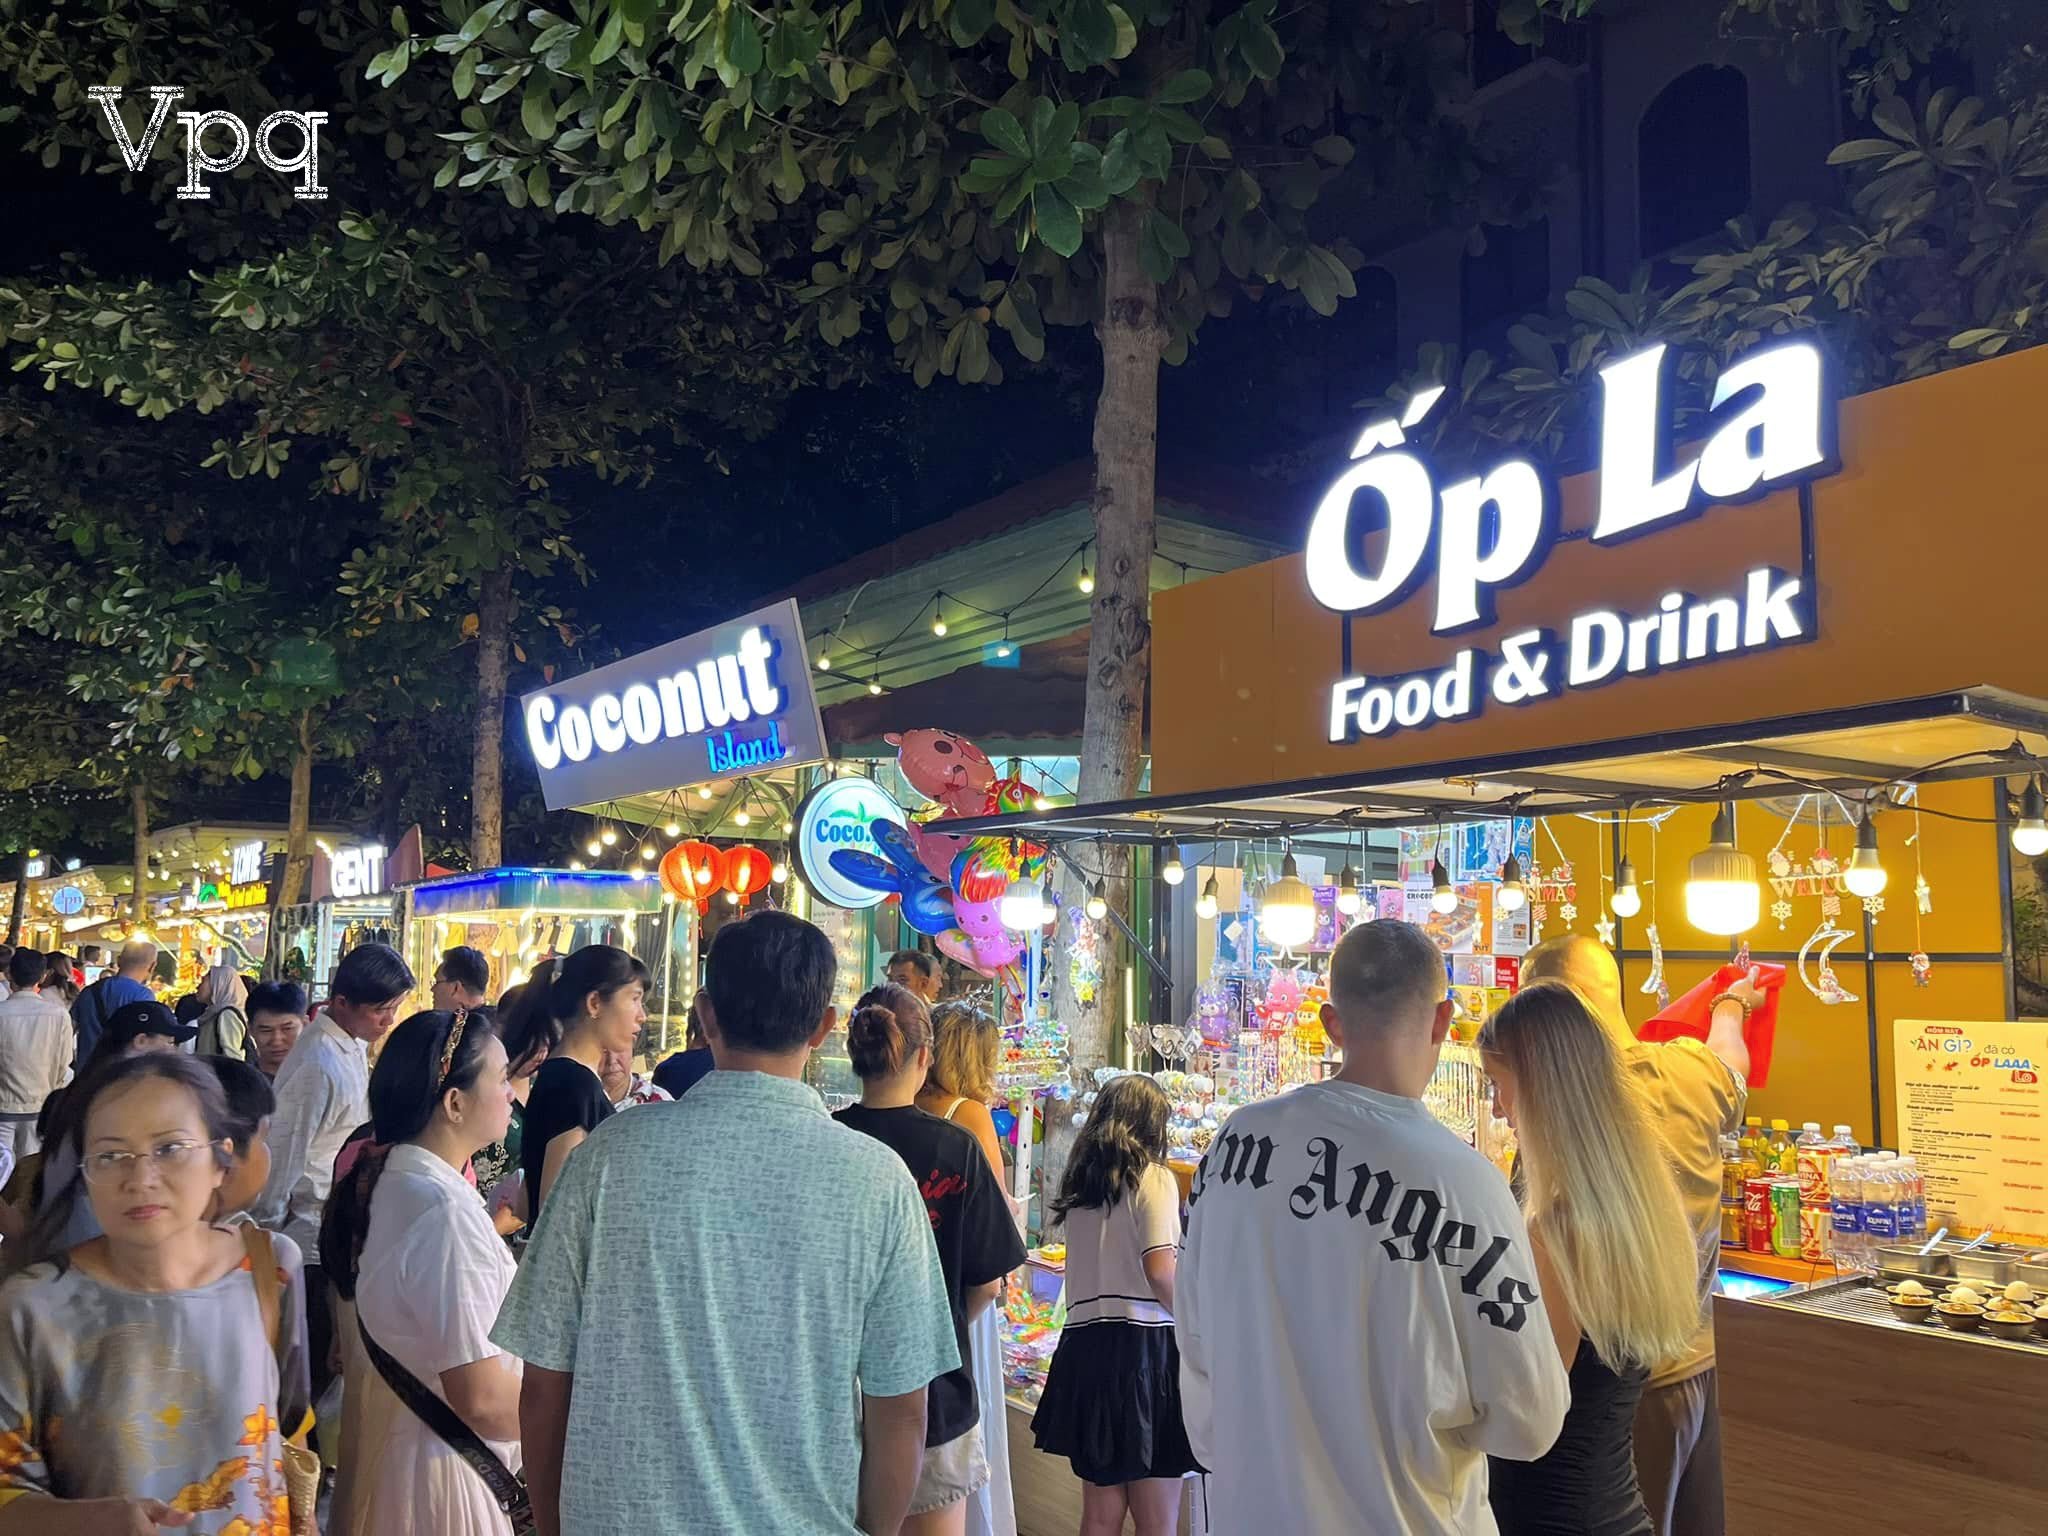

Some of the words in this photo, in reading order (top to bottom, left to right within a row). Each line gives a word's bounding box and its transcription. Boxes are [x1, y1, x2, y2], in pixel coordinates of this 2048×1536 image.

[1305, 385, 1544, 632] Ốp
[1592, 342, 1825, 540] La
[526, 626, 779, 770] Coconut
[1329, 650, 1474, 743] Food
[1492, 629, 1550, 706] &
[1569, 567, 1803, 689] Drink
[706, 720, 786, 773] Island
[331, 844, 384, 898] GENT
[1994, 1058, 2030, 1069] LAAA
[1289, 1136, 1539, 1332] Angels
